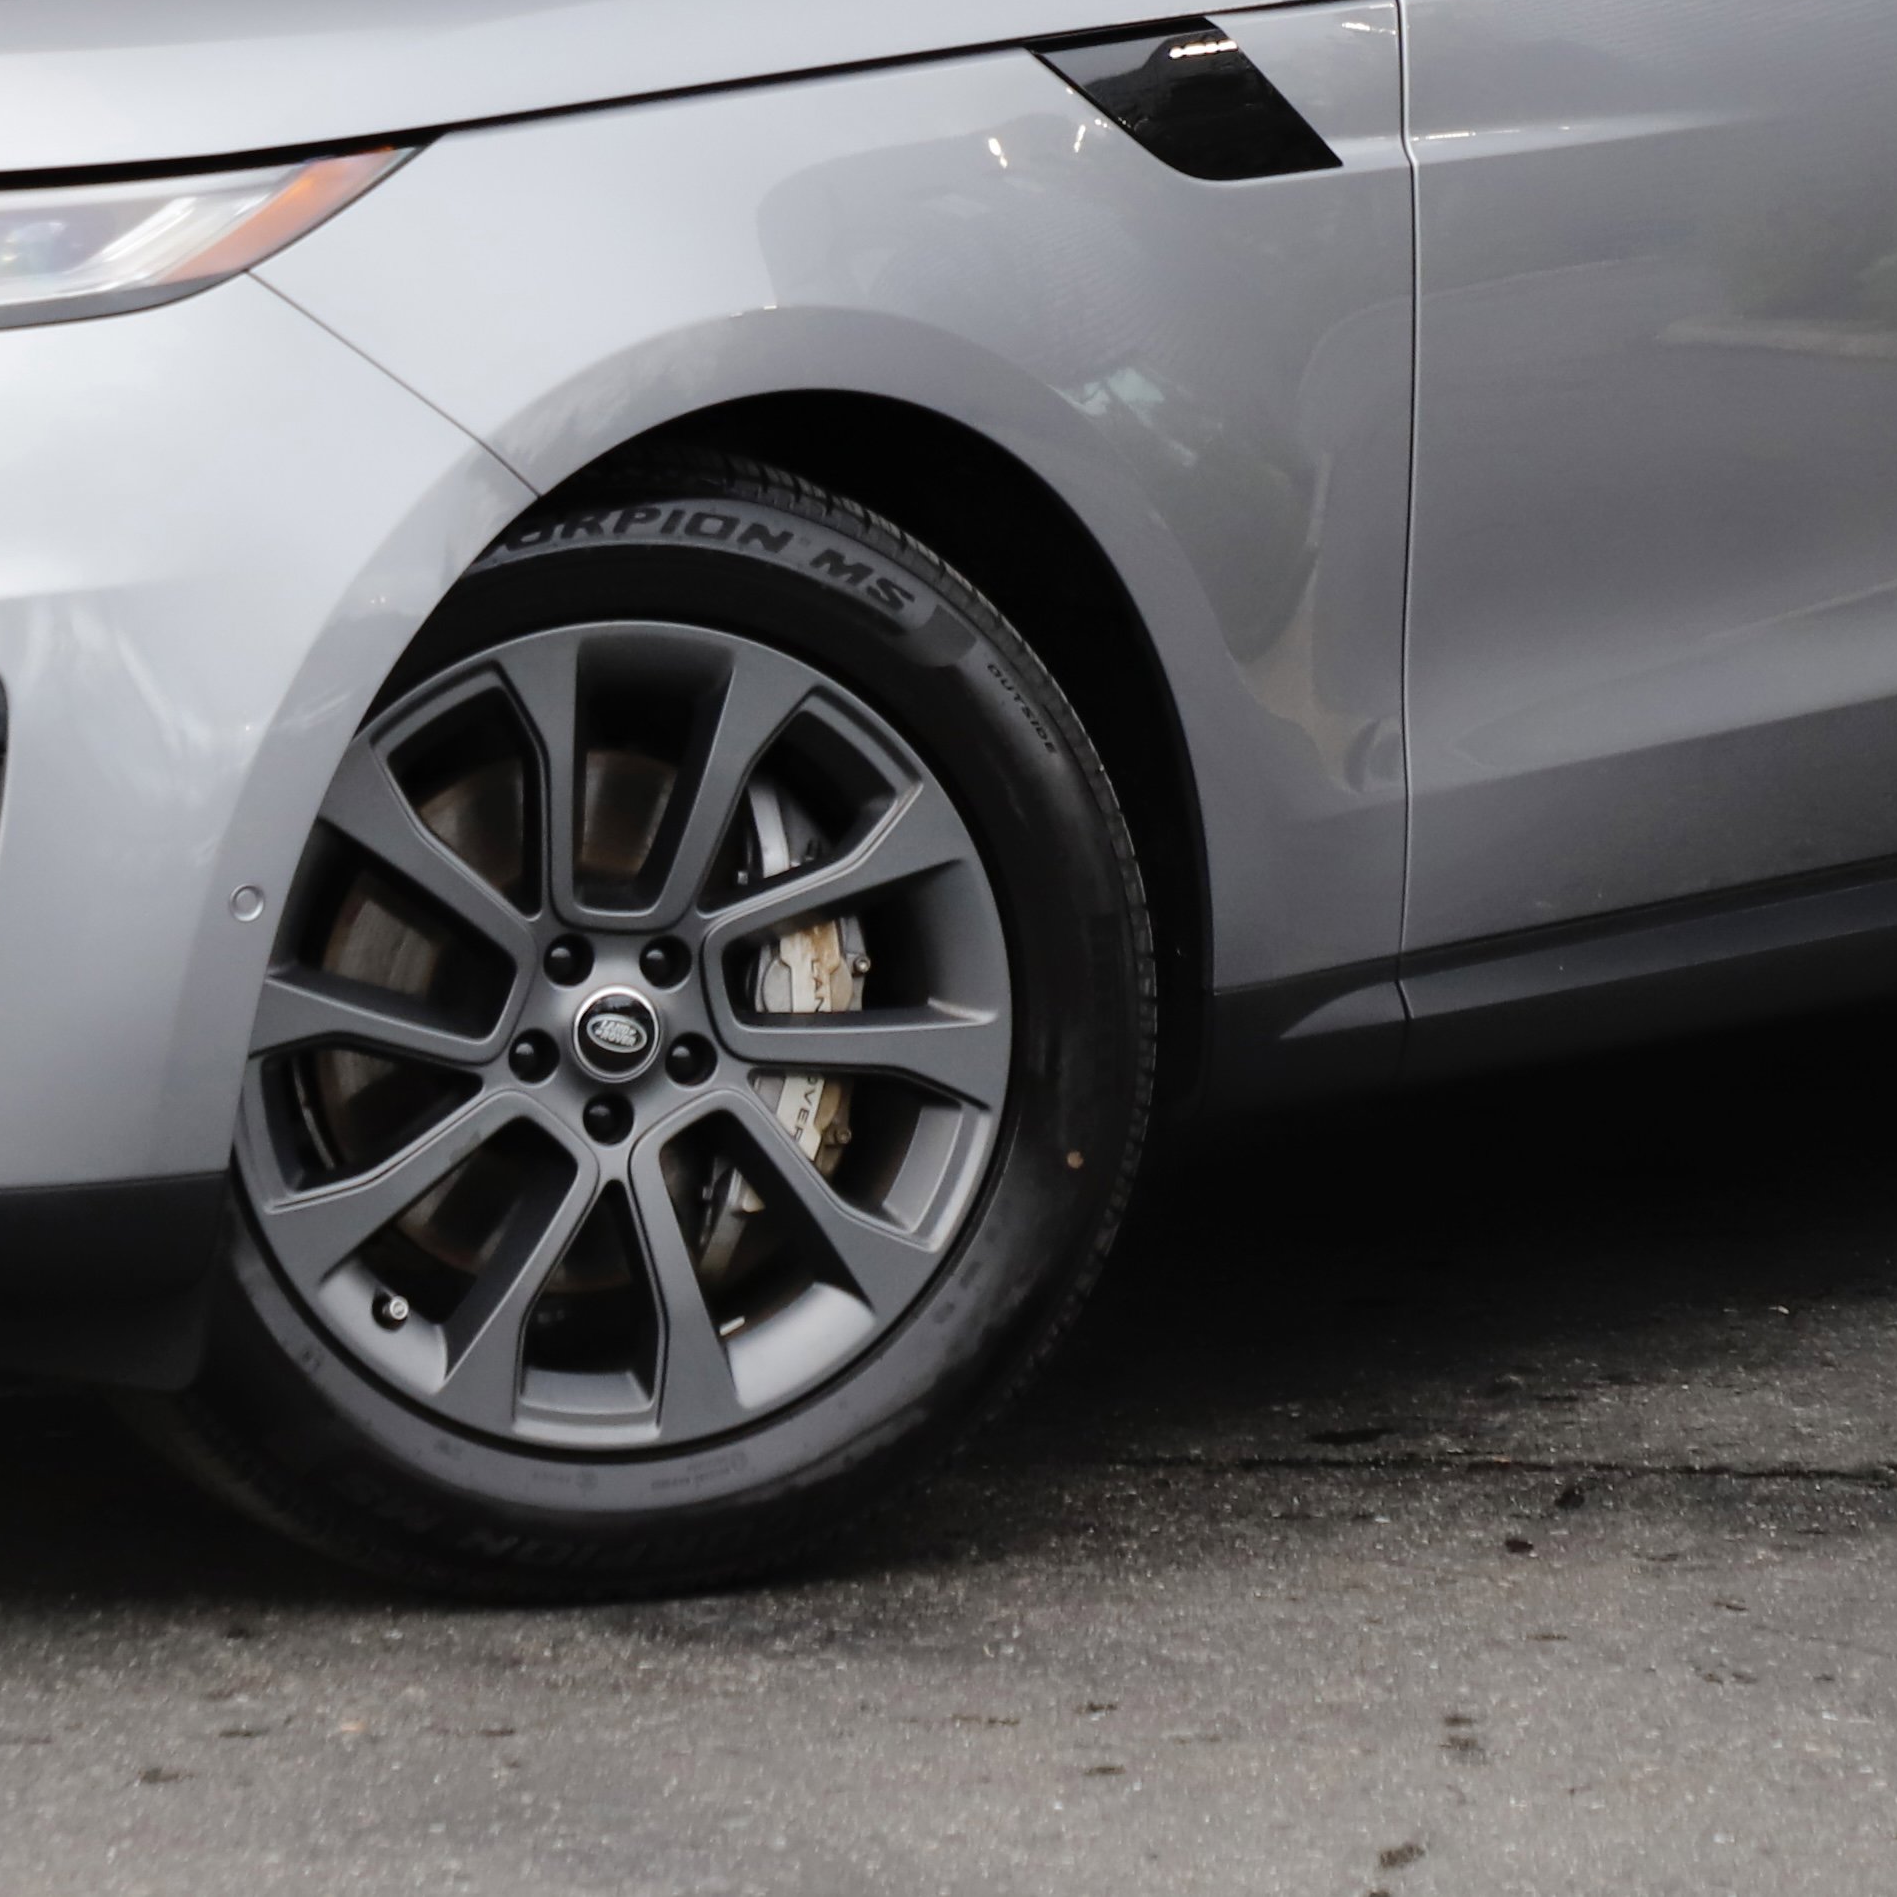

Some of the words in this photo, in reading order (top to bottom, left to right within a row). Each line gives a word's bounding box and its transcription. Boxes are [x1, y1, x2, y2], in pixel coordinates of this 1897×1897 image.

[502, 507, 794, 555] ORPION
[808, 547, 917, 613] MS
[987, 664, 1057, 754] OUTSIDE
[810, 959, 826, 1013] LAN
